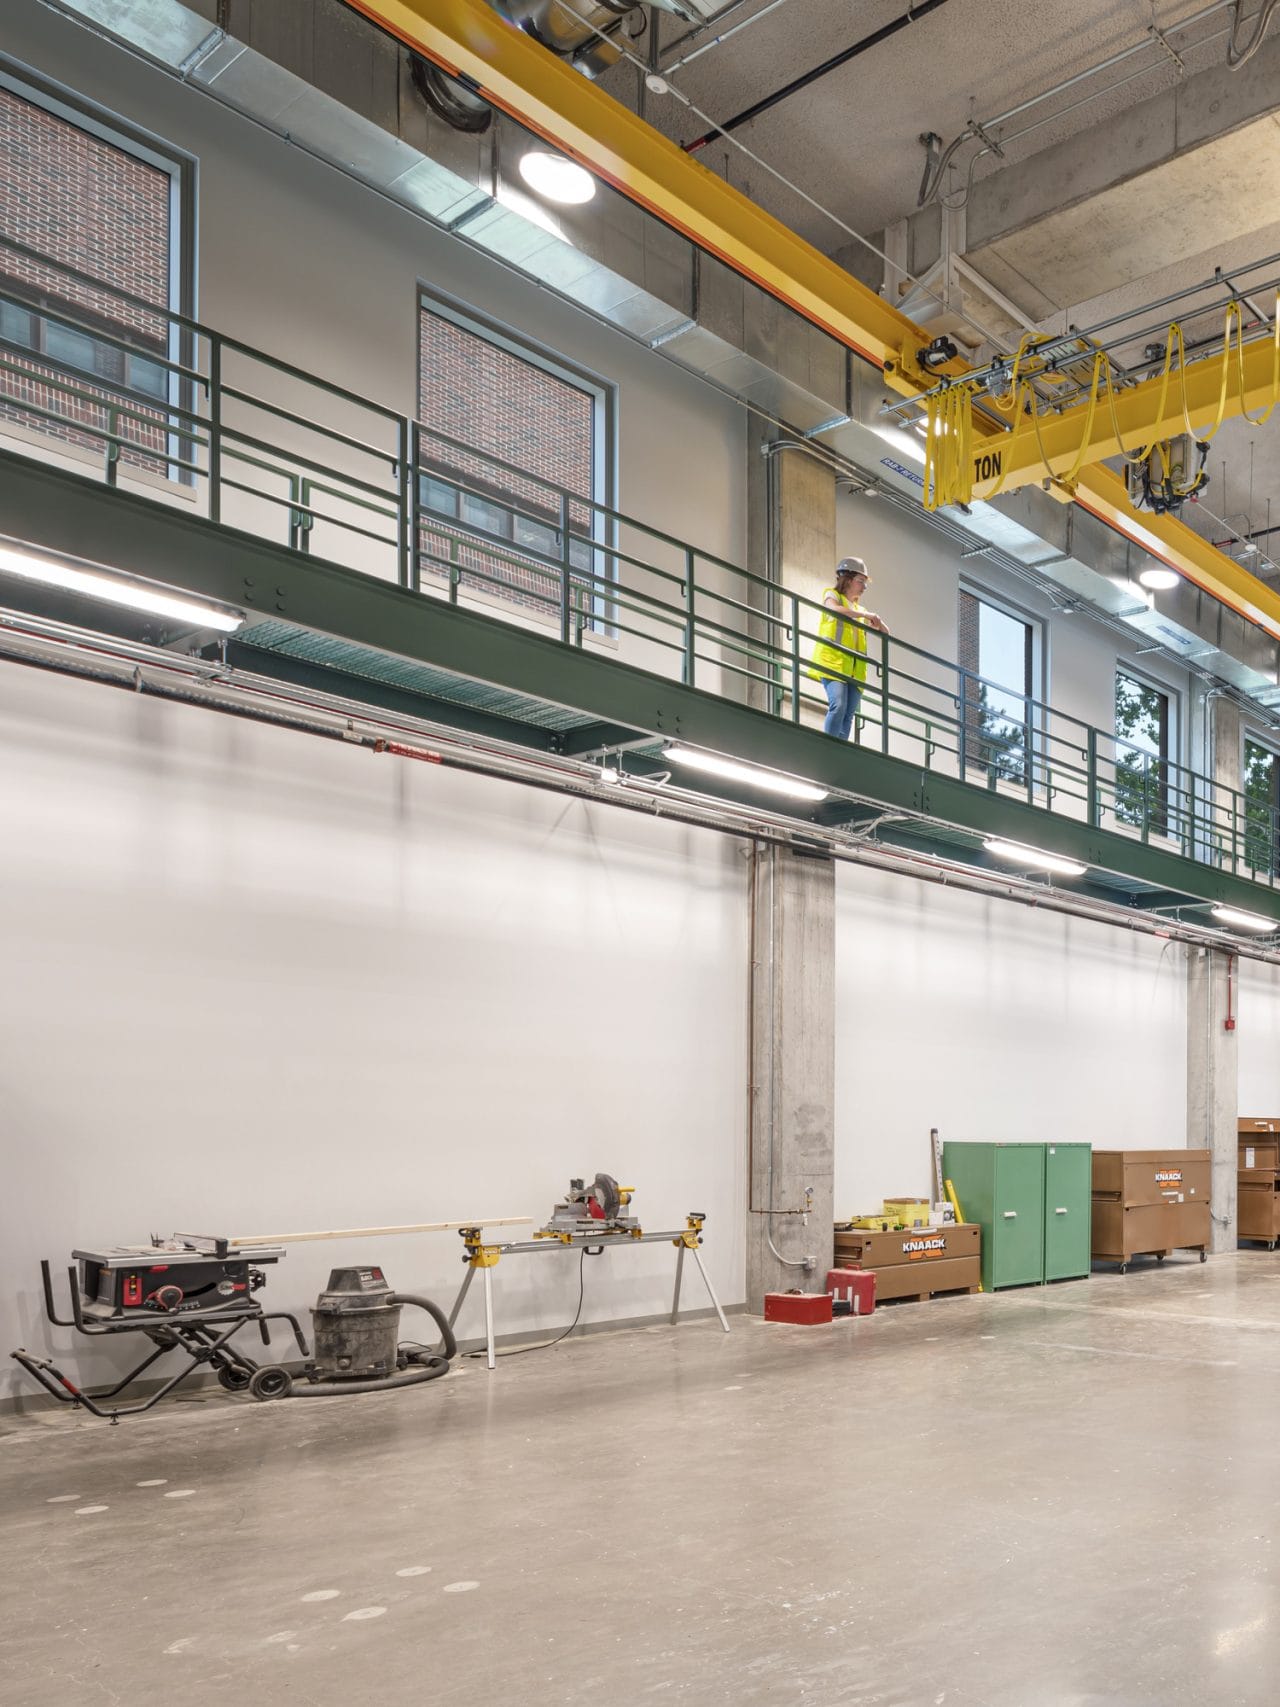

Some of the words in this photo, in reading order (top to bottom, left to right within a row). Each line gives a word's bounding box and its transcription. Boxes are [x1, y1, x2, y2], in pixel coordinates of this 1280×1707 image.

[974, 450, 1002, 483] TON
[900, 468, 924, 486] RETUR
[1155, 1172, 1182, 1182] KNAACK
[902, 1239, 946, 1253] KNAACK
